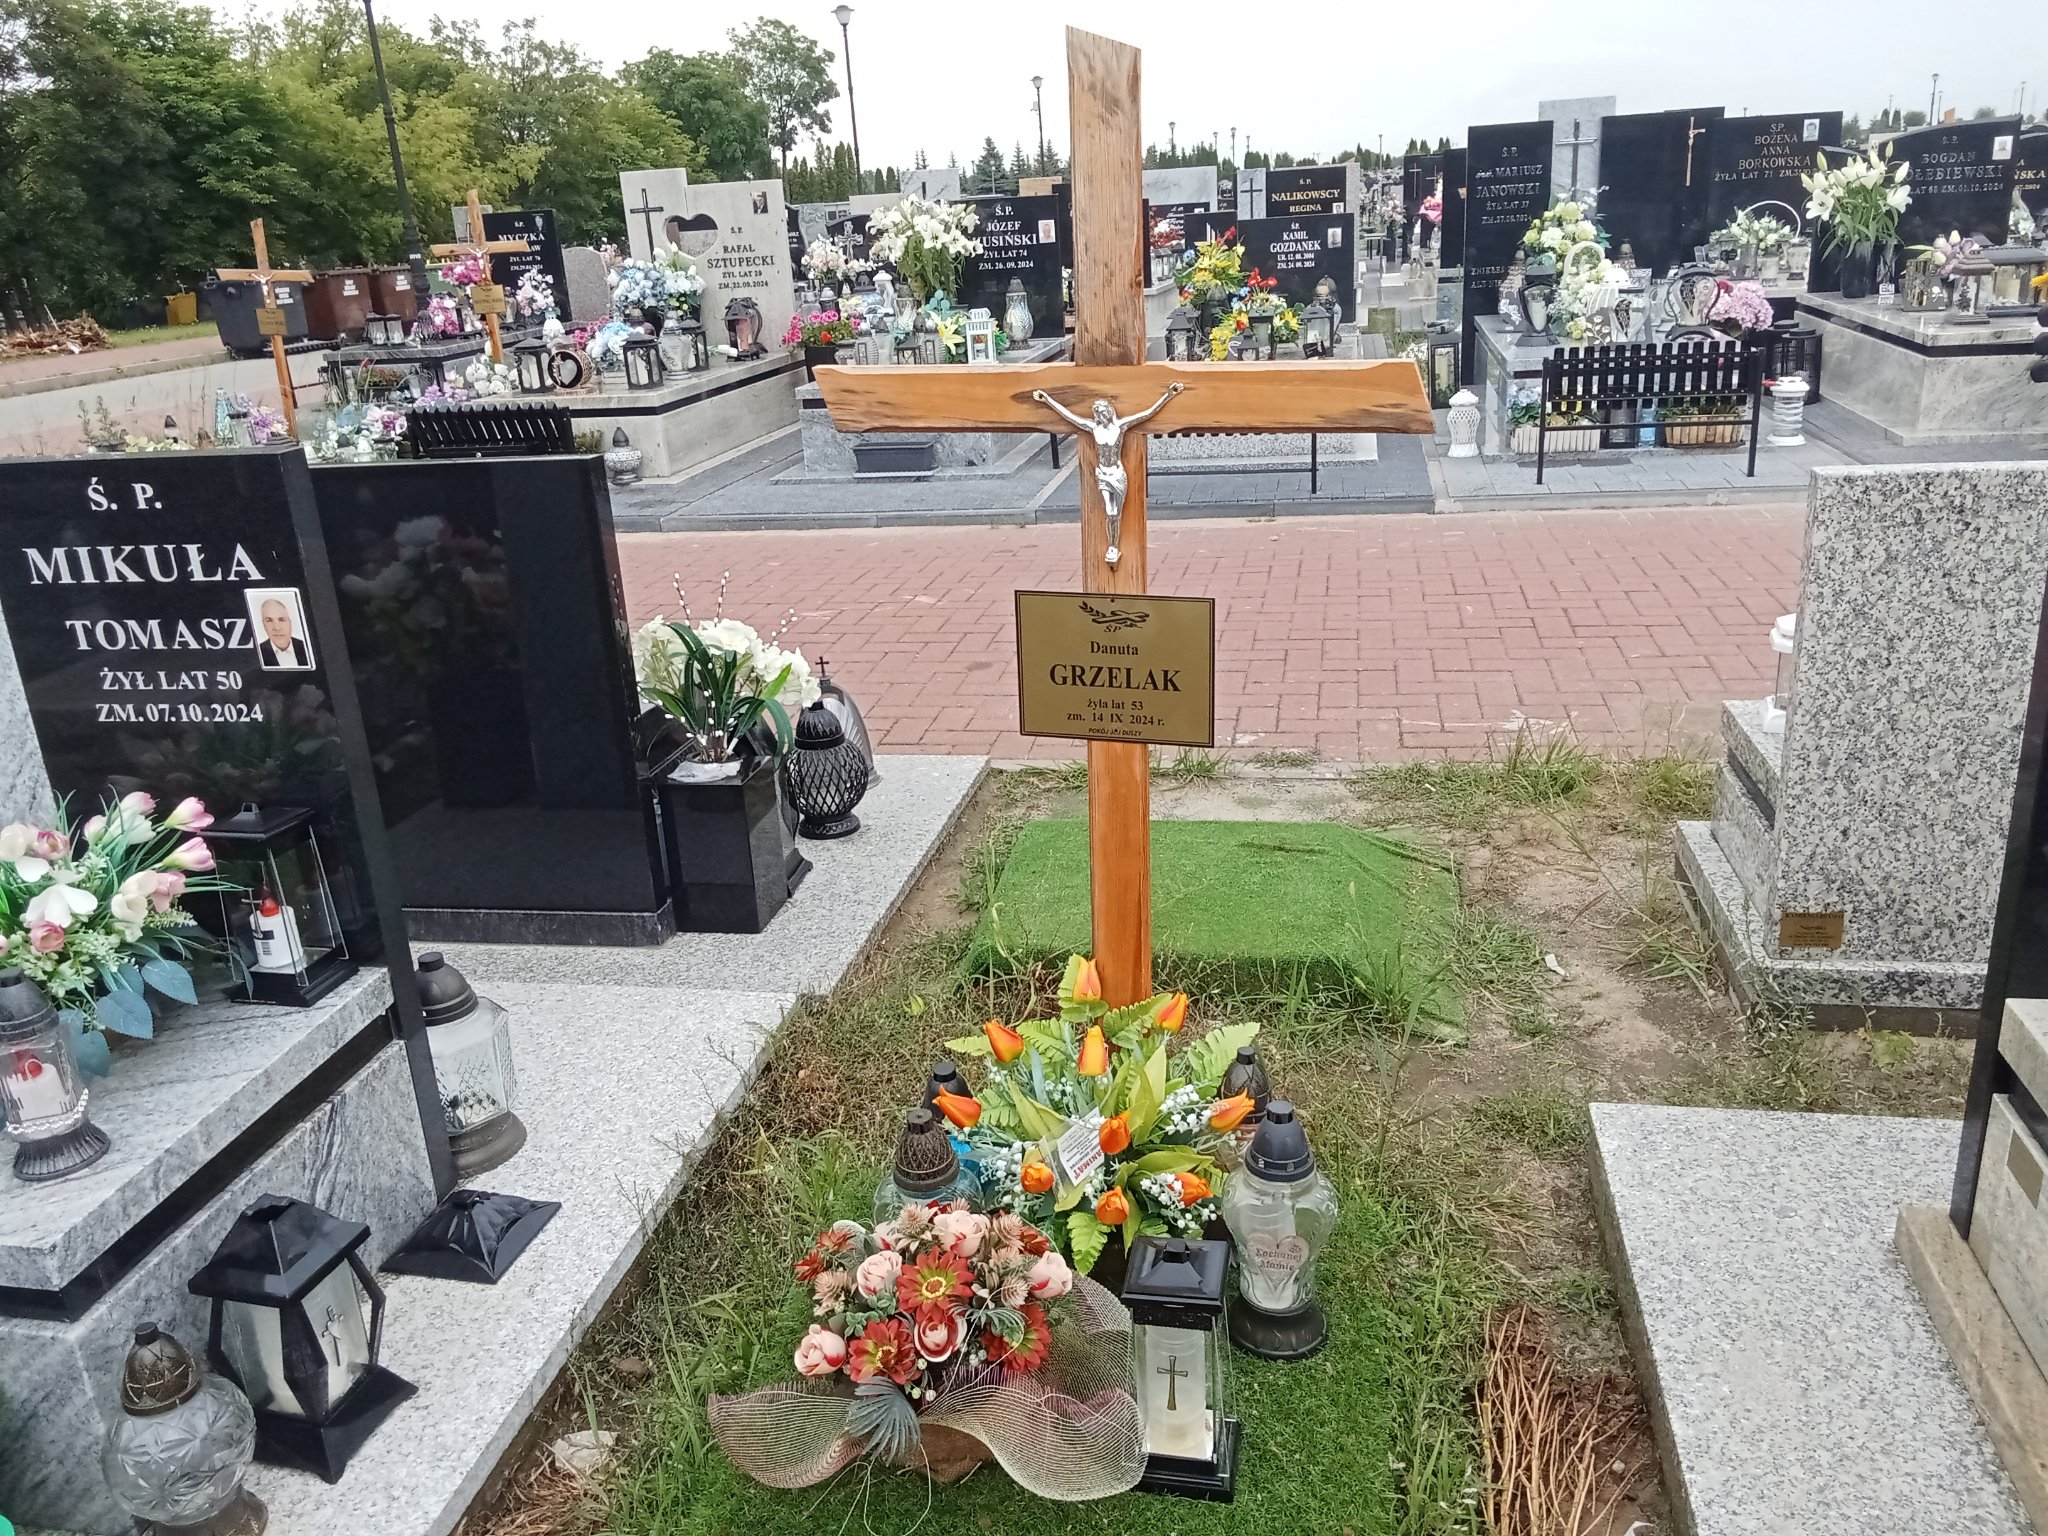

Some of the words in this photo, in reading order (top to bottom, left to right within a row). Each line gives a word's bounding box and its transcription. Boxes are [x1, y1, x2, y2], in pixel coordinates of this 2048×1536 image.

[1754, 133, 1798, 145] BOŻENA
[1761, 146, 1790, 156] ANNA
[1738, 156, 1811, 170] BORKOWSKA
[1921, 152, 1976, 165] BOGDAN
[1495, 164, 1543, 177] MARIUSZ
[1715, 171, 1737, 182] ŻYŁA
[1742, 171, 1759, 180] LAT
[1764, 170, 1773, 179] 71
[1271, 189, 1341, 201] NALIKOWSCY
[1476, 182, 1540, 197] JANOWSKI
[1005, 206, 1014, 216] P.
[1289, 203, 1322, 213] REGINA
[1503, 201, 1519, 210] LAT
[986, 219, 1022, 232] JÓZEF
[498, 232, 545, 243] MYCZKA
[1283, 231, 1309, 241] KAMIL
[723, 243, 756, 254] RAFAŁ
[1269, 240, 1321, 253] GOZDANEK
[1001, 249, 1018, 258] LAT
[1019, 249, 1028, 257] 74
[707, 255, 775, 269] SZTUPECKI
[978, 262, 994, 271] ZM.
[1017, 259, 1034, 269] 2024
[738, 270, 752, 278] LAT
[87, 477, 118, 511] Ś.
[132, 483, 163, 509] P.
[22, 542, 266, 584] MIKUŁA
[65, 618, 255, 650] TOMASZ
[1089, 640, 1139, 656] Danuta
[100, 666, 154, 690] ŻYŁ
[158, 671, 209, 690] LAT
[216, 671, 243, 690] 50
[1049, 663, 1182, 692] GRZELAK
[1111, 699, 1125, 710] lat
[1131, 700, 1144, 711] 53
[1066, 712, 1086, 722] zm.
[1092, 712, 1104, 723] 14
[1110, 713, 1123, 724] IX
[1129, 714, 1154, 726] 2024
[1157, 717, 1165, 726] r.
[1122, 729, 1143, 737] DUSZY
[1255, 1248, 1302, 1262] Kochanej
[1257, 1261, 1295, 1271] Mamie
